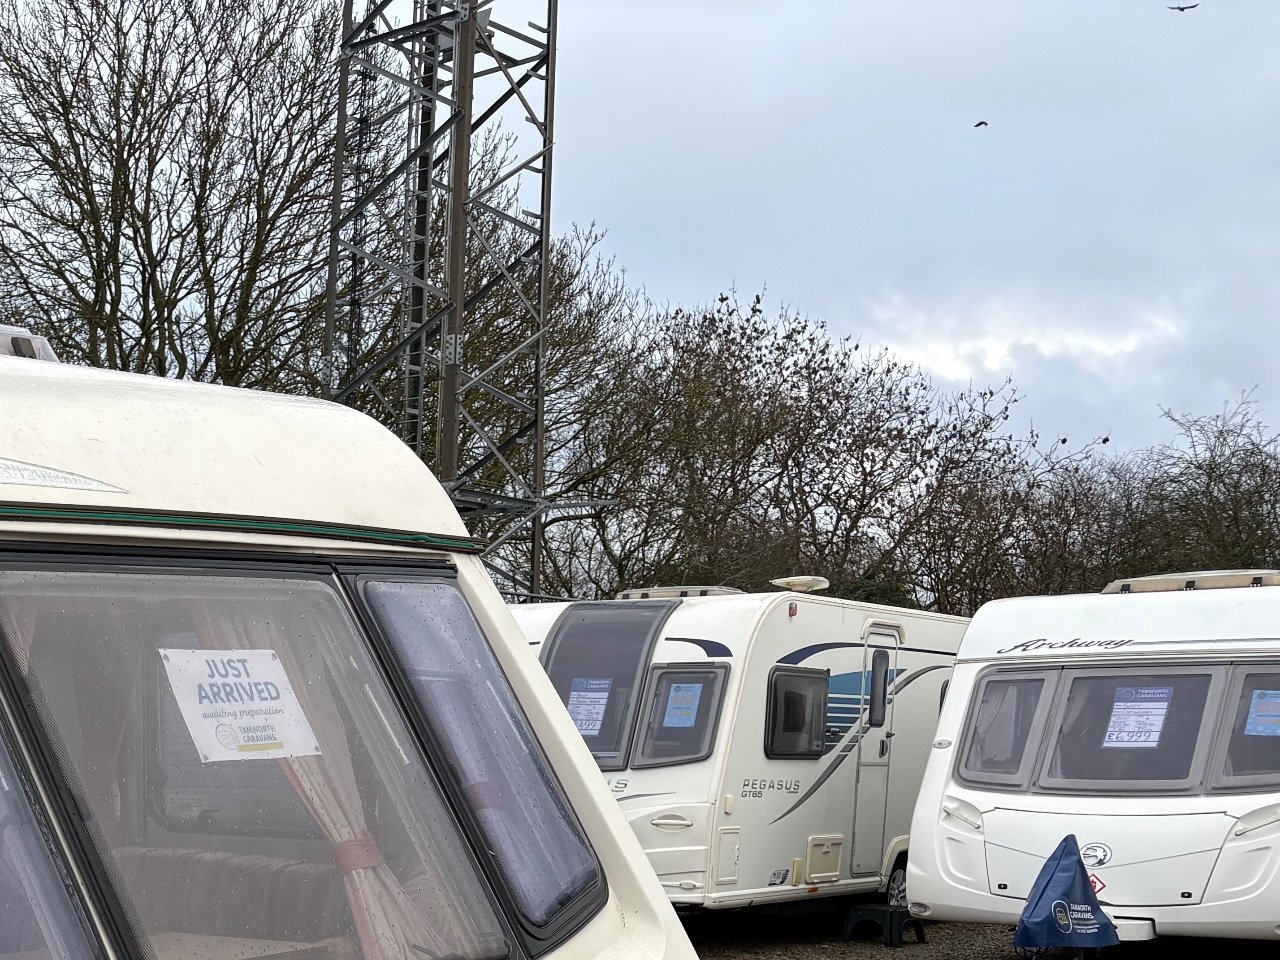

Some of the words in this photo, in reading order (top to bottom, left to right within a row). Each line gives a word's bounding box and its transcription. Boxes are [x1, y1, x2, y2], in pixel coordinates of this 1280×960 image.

[997, 638, 1134, 654] Archway
[205, 658, 251, 679] JUST
[197, 681, 281, 704] ARRIVED
[202, 708, 237, 720] awaiting
[239, 706, 285, 719] preparation
[238, 725, 276, 734] TAMWORTH
[243, 734, 277, 743] CARAVANS
[742, 779, 800, 791] PEGASUS
